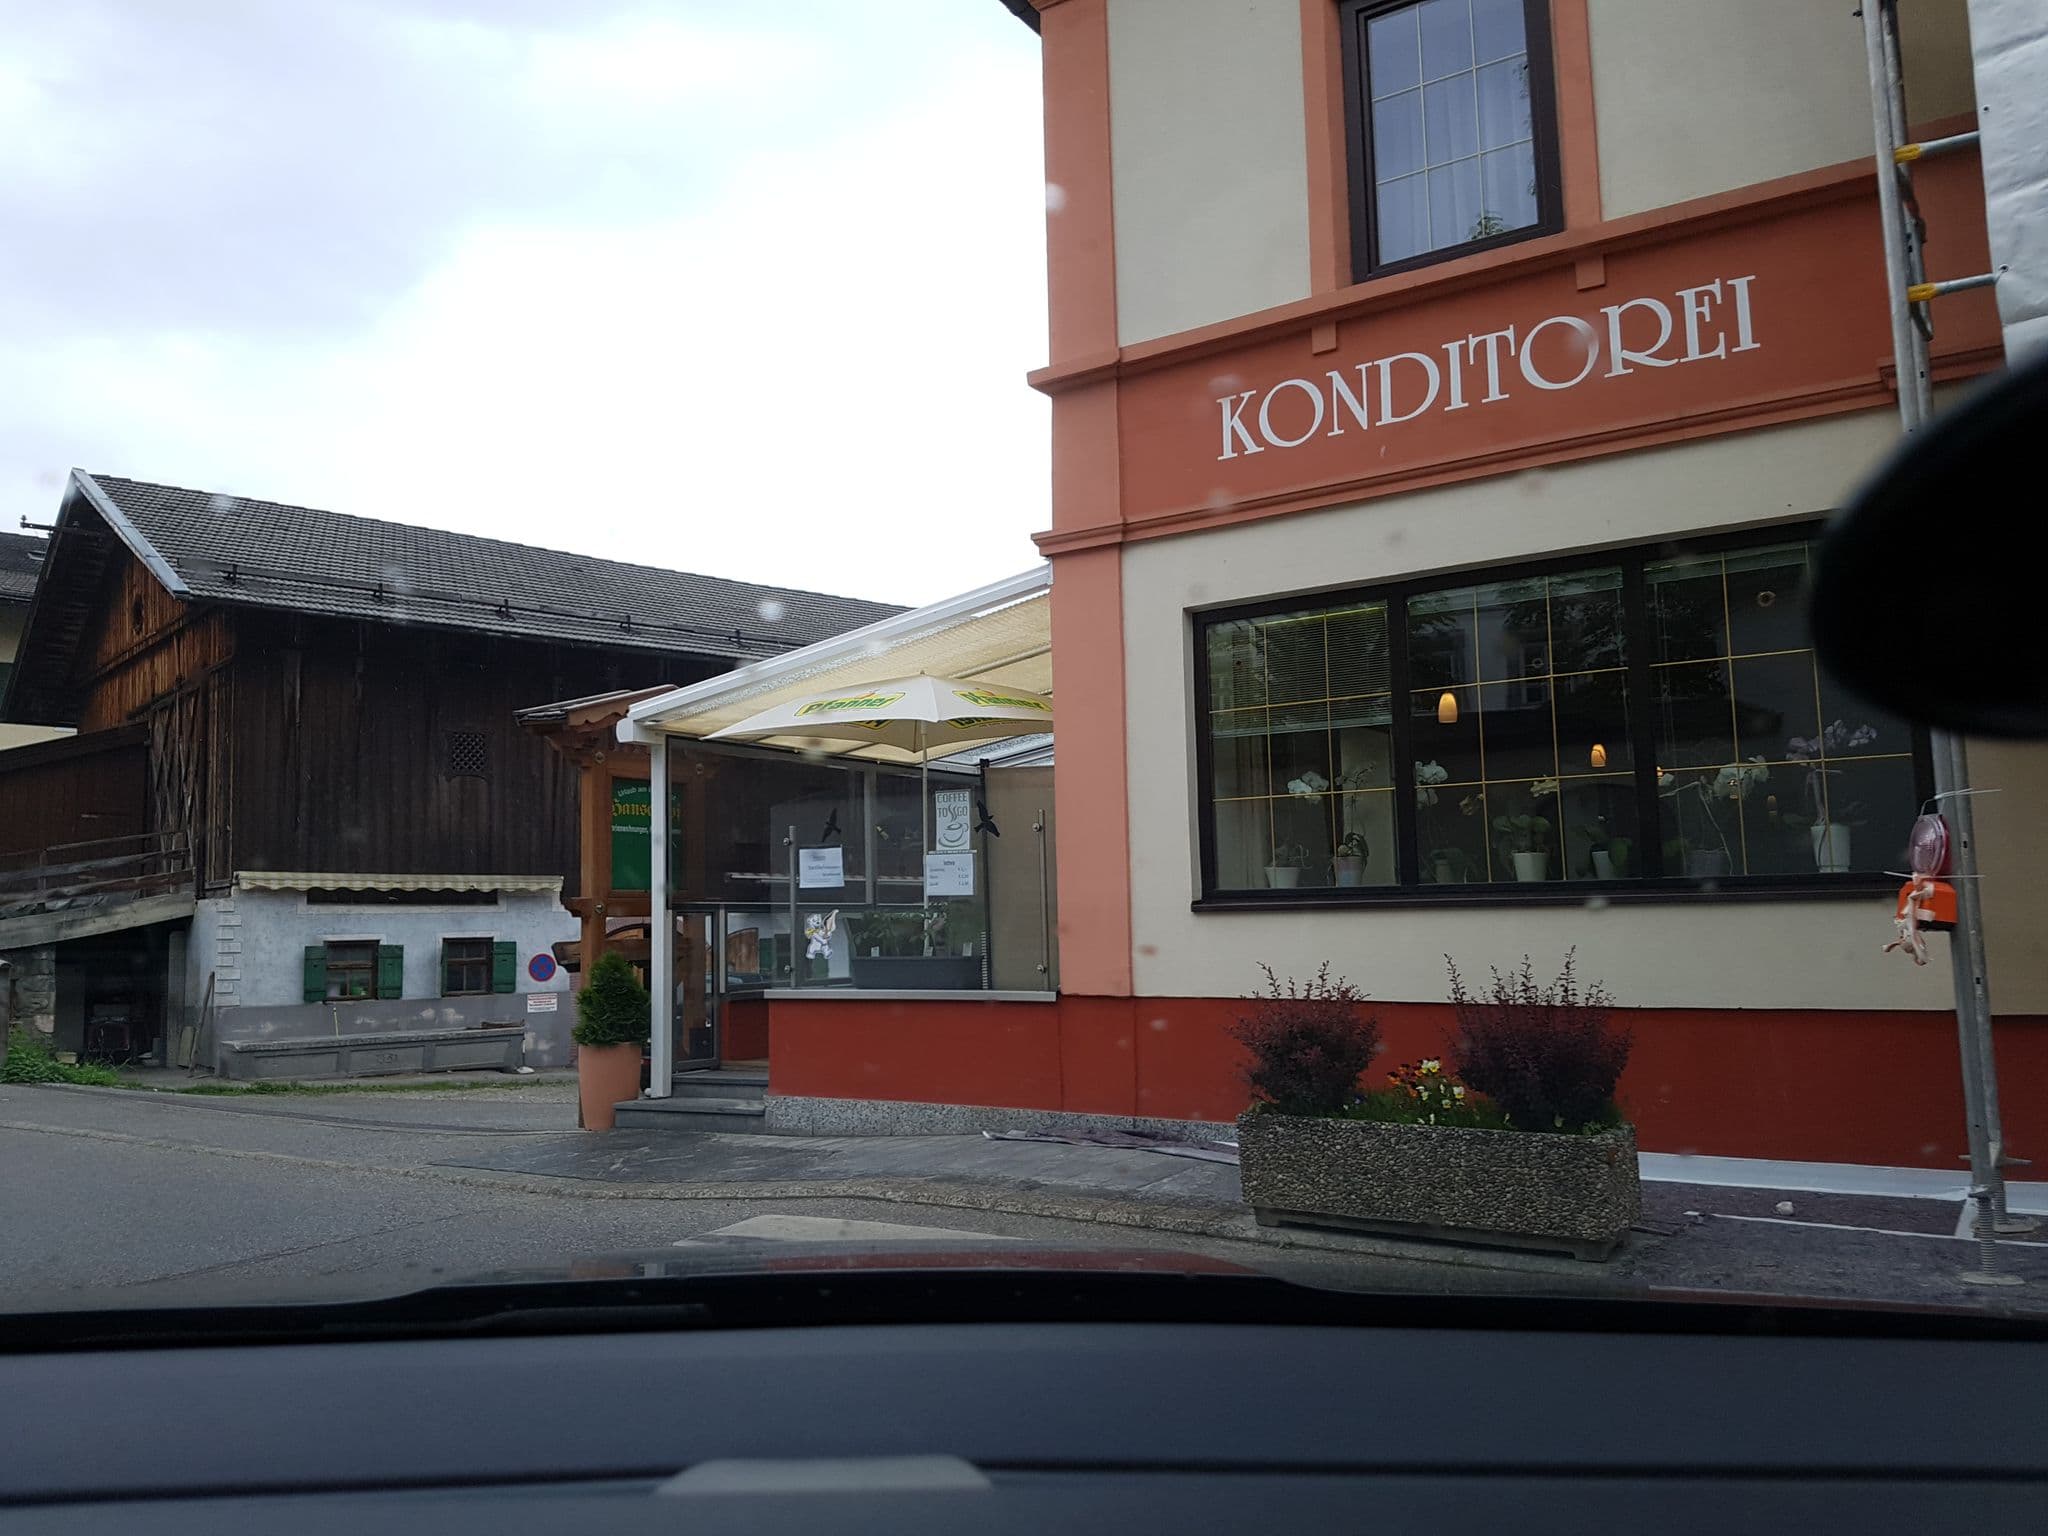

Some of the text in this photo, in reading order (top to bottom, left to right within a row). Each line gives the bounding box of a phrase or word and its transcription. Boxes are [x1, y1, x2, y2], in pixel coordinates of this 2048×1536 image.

[1217, 275, 1761, 460] KONDITOREI
[937, 793, 968, 803] COFFEE
[937, 807, 948, 818] TO
